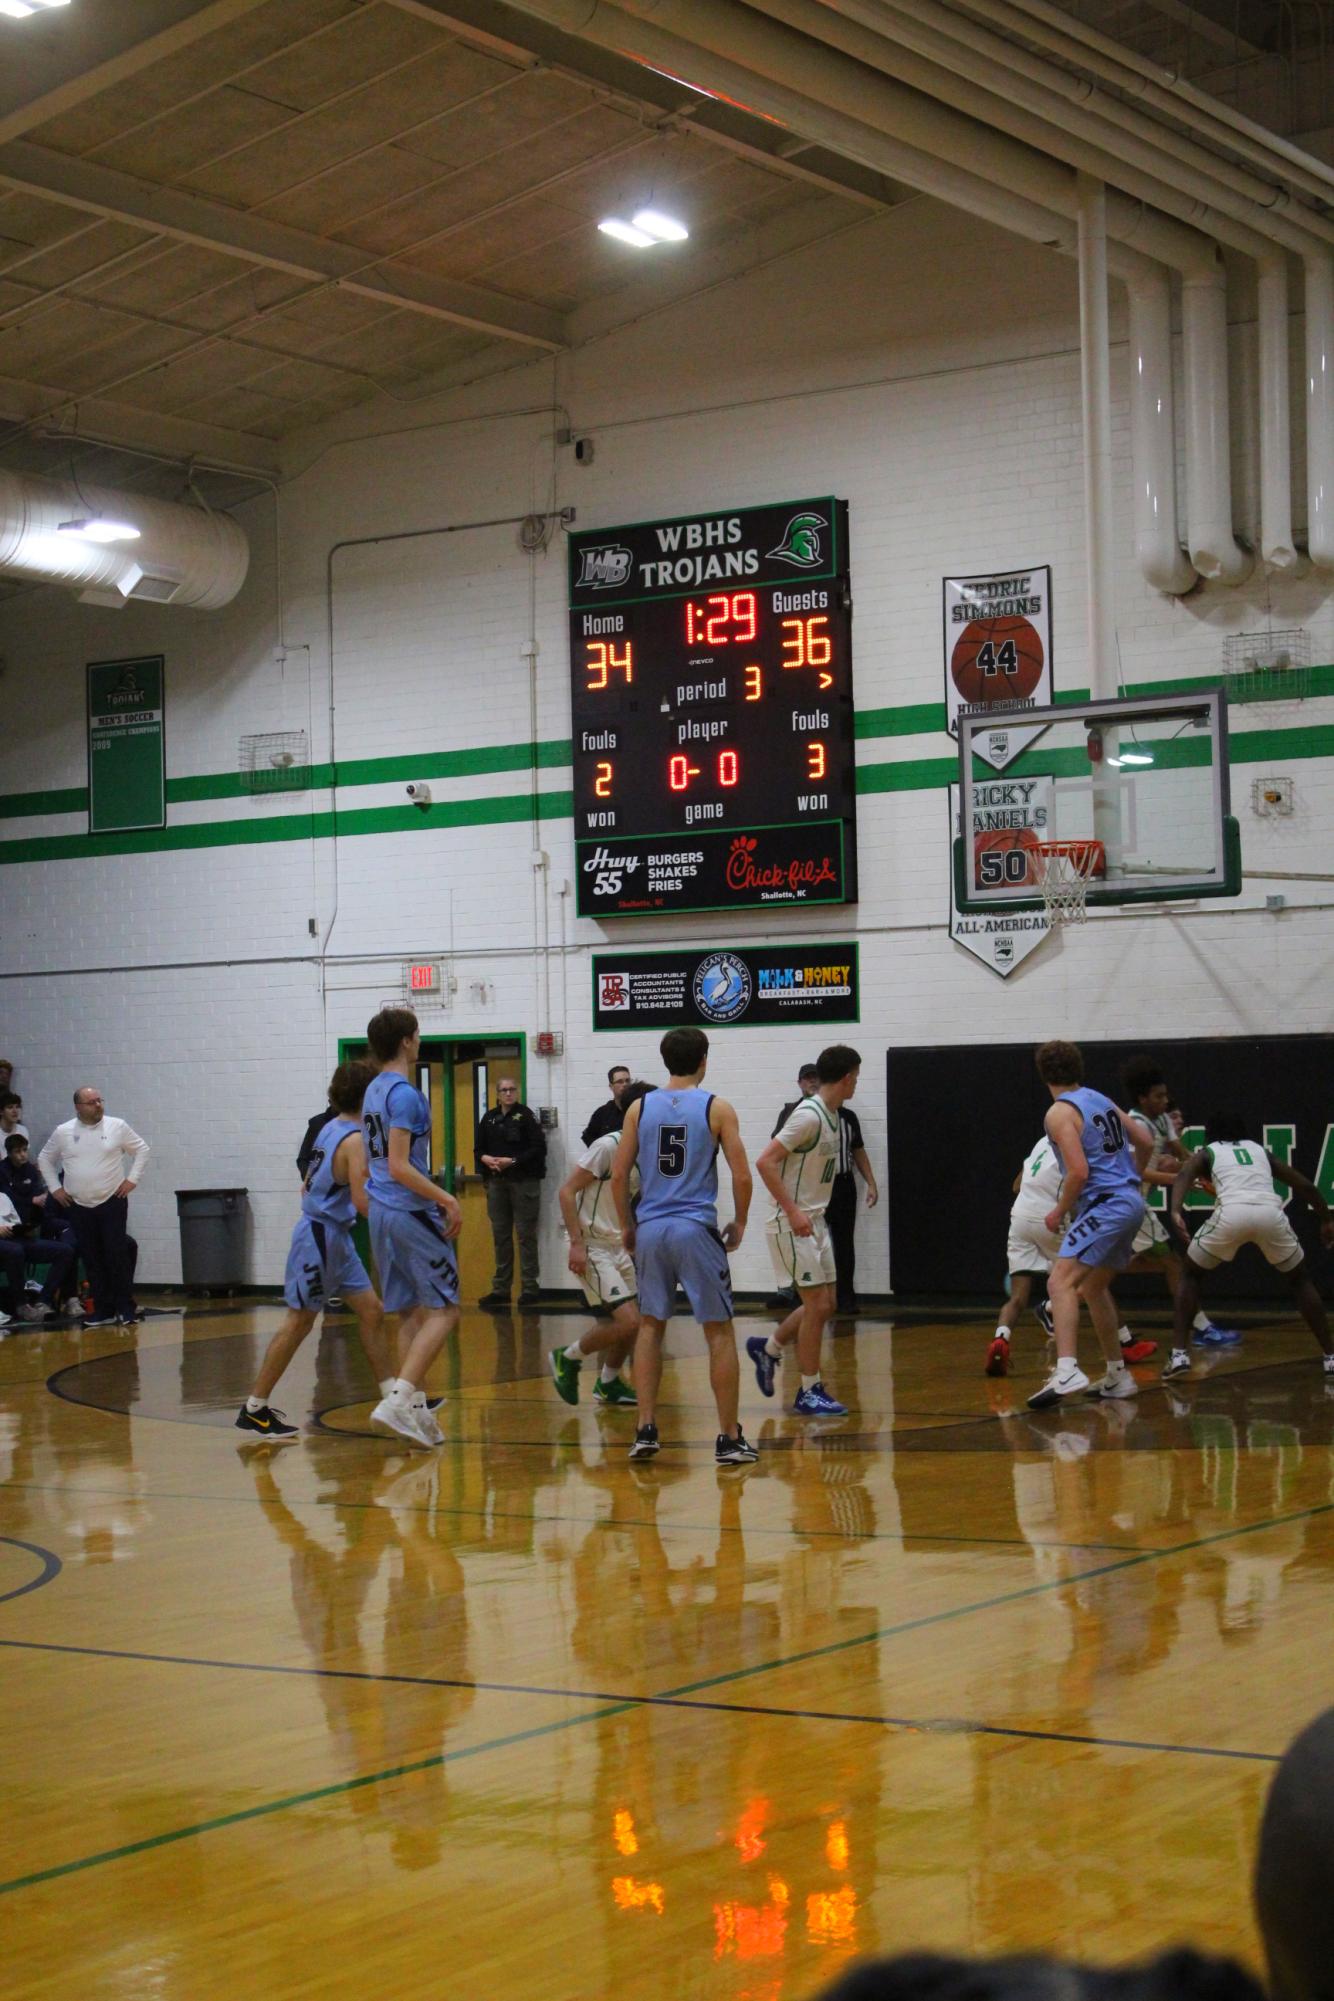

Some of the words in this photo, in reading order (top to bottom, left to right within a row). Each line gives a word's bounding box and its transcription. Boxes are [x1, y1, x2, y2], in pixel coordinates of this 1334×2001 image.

[656, 518, 742, 553] WBHS
[580, 546, 632, 587] WB
[639, 549, 759, 587] TROJANS
[772, 589, 828, 613] Guests
[951, 597, 1042, 624] SIMMONS
[583, 614, 624, 636] Home
[686, 593, 756, 645] 1:29
[782, 616, 831, 668] 36
[586, 642, 632, 689] 34
[976, 639, 1018, 677] 44
[676, 678, 727, 706] period
[745, 666, 761, 700] 3
[98, 715, 122, 726] MEN'S
[125, 712, 154, 724] SOCCER
[678, 718, 728, 744] player
[792, 709, 829, 731] fouls
[582, 731, 617, 751] fouls
[719, 751, 737, 786] 0
[808, 743, 825, 779] 3
[595, 763, 612, 796] 2
[685, 803, 724, 825] game
[797, 793, 828, 811] won
[587, 810, 616, 828] won
[583, 847, 640, 874] Hwy
[647, 851, 704, 867] BURGERS
[648, 865, 697, 879] SHAKES
[726, 846, 837, 890] Chick-fil-A
[980, 850, 1028, 885] 50
[593, 871, 623, 896] 55
[648, 879, 683, 893] FRIES
[955, 915, 1055, 935] ALL-AMERICAN
[411, 965, 432, 989] EXIT
[696, 954, 728, 984] PELICAN'S
[729, 957, 748, 983] PERCH
[758, 968, 794, 989] MILK
[794, 969, 803, 982] &
[803, 966, 850, 987] HONEY
[633, 979, 683, 987] ACCOUNTANTS
[364, 1112, 389, 1160] 21
[1091, 1108, 1125, 1154] 30
[658, 1124, 687, 1178] 5
[1031, 1149, 1048, 1178] 4
[1233, 1148, 1254, 1166] 0
